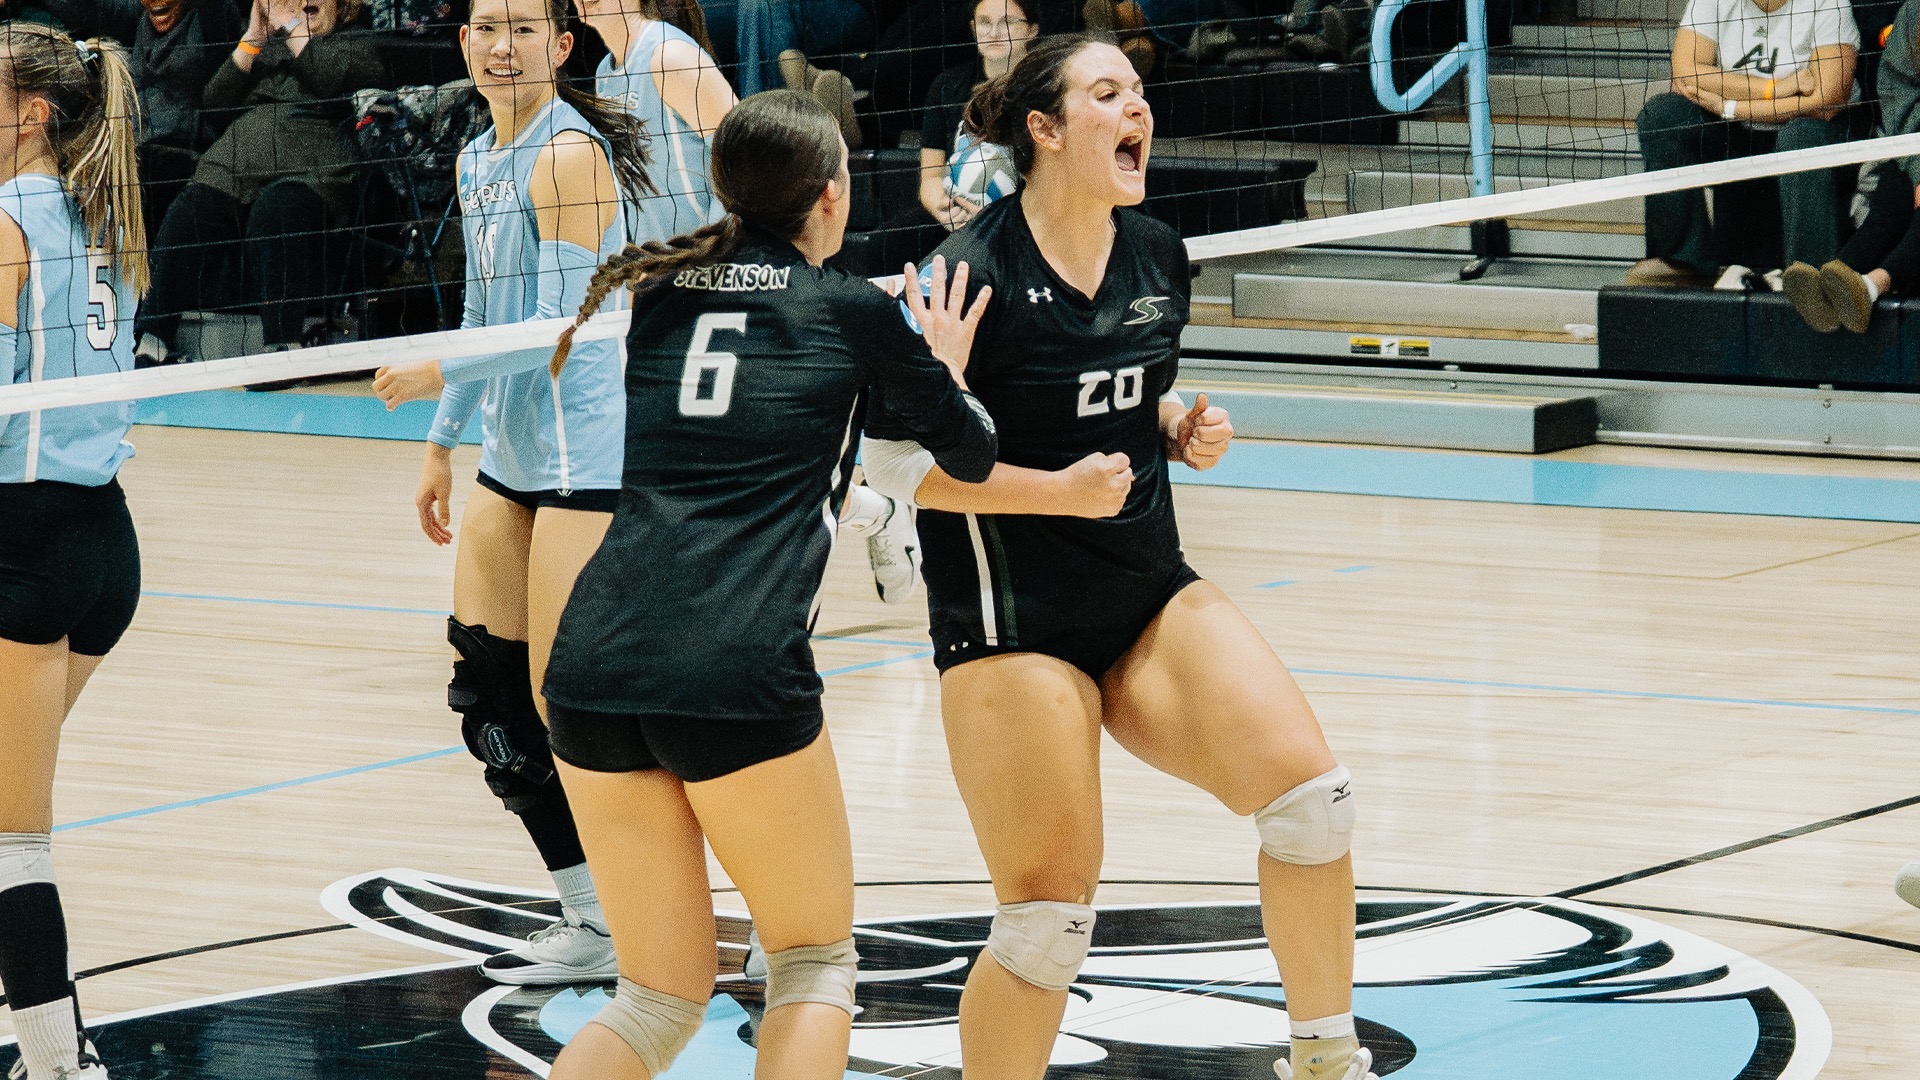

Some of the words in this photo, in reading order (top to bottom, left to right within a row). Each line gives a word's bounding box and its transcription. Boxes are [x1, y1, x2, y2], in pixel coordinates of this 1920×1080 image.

[85, 245, 118, 351] 5
[679, 312, 748, 416] 6
[1077, 367, 1145, 417] 20
